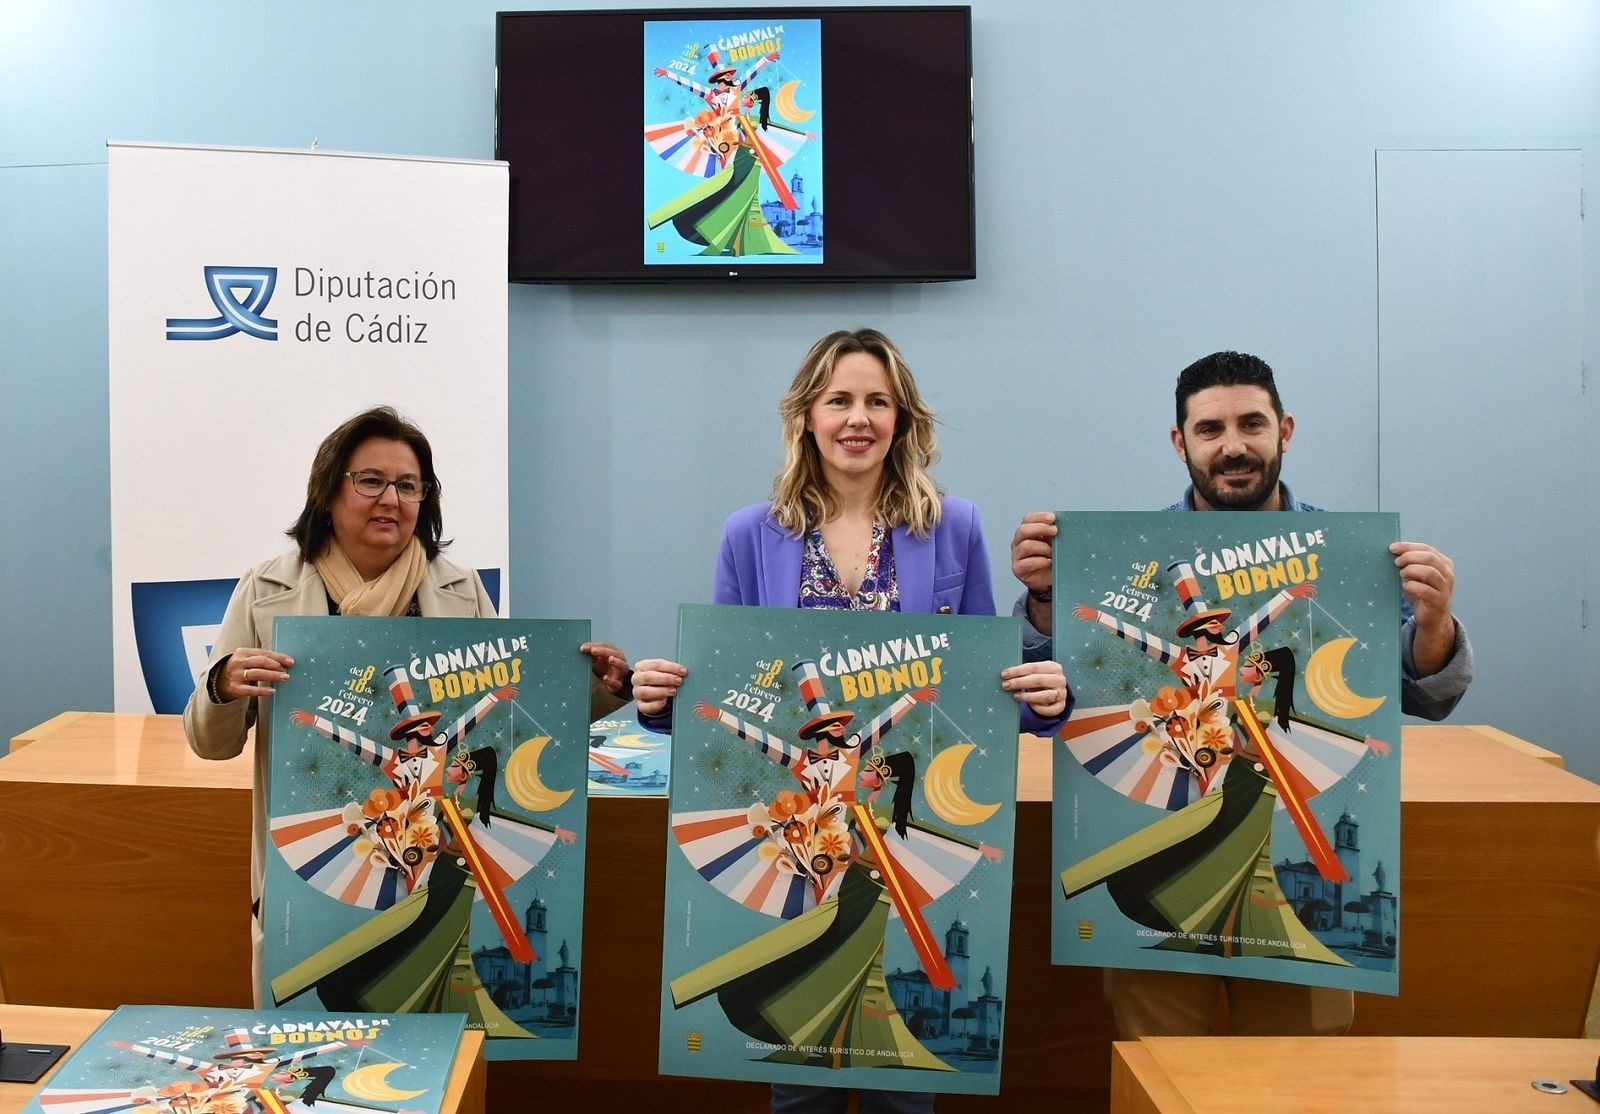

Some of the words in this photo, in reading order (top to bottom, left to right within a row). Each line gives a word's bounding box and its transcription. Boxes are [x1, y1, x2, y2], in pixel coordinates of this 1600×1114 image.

[718, 26, 775, 51] CARNAVAL
[668, 60, 696, 76] 2024
[295, 267, 456, 303] Diputación
[295, 313, 331, 343] de
[346, 313, 428, 344] Cádiz
[1194, 531, 1306, 576] CARNAVAL
[1305, 529, 1324, 547] DE
[1131, 561, 1147, 573] del
[1146, 560, 1159, 577] 8
[1216, 553, 1319, 600] BORNOS
[1131, 574, 1151, 589] 18
[1100, 591, 1153, 623] 2024
[409, 637, 511, 681] CARNAVAL
[511, 635, 528, 652] DE
[820, 634, 931, 677] CARNAVAL
[930, 632, 949, 650] DE
[349, 666, 364, 677] del
[363, 665, 376, 681] 8
[756, 659, 771, 671] del
[770, 659, 784, 676] 8
[348, 678, 368, 693] 18
[428, 658, 522, 703] BORNOS
[754, 672, 775, 688] 18
[840, 656, 943, 702] BORNOS
[316, 695, 368, 726] 2024
[721, 689, 776, 723] 2024
[1136, 930, 1177, 938] DECLARADO
[1256, 938, 1266, 946] DE
[252, 1018, 370, 1035] CARNAVAL
[371, 1018, 390, 1026] DE
[270, 1027, 380, 1045] BORNOS
[139, 1036, 196, 1052] 2024
[745, 1042, 787, 1051] DECLARADO
[787, 1044, 797, 1052] DE
